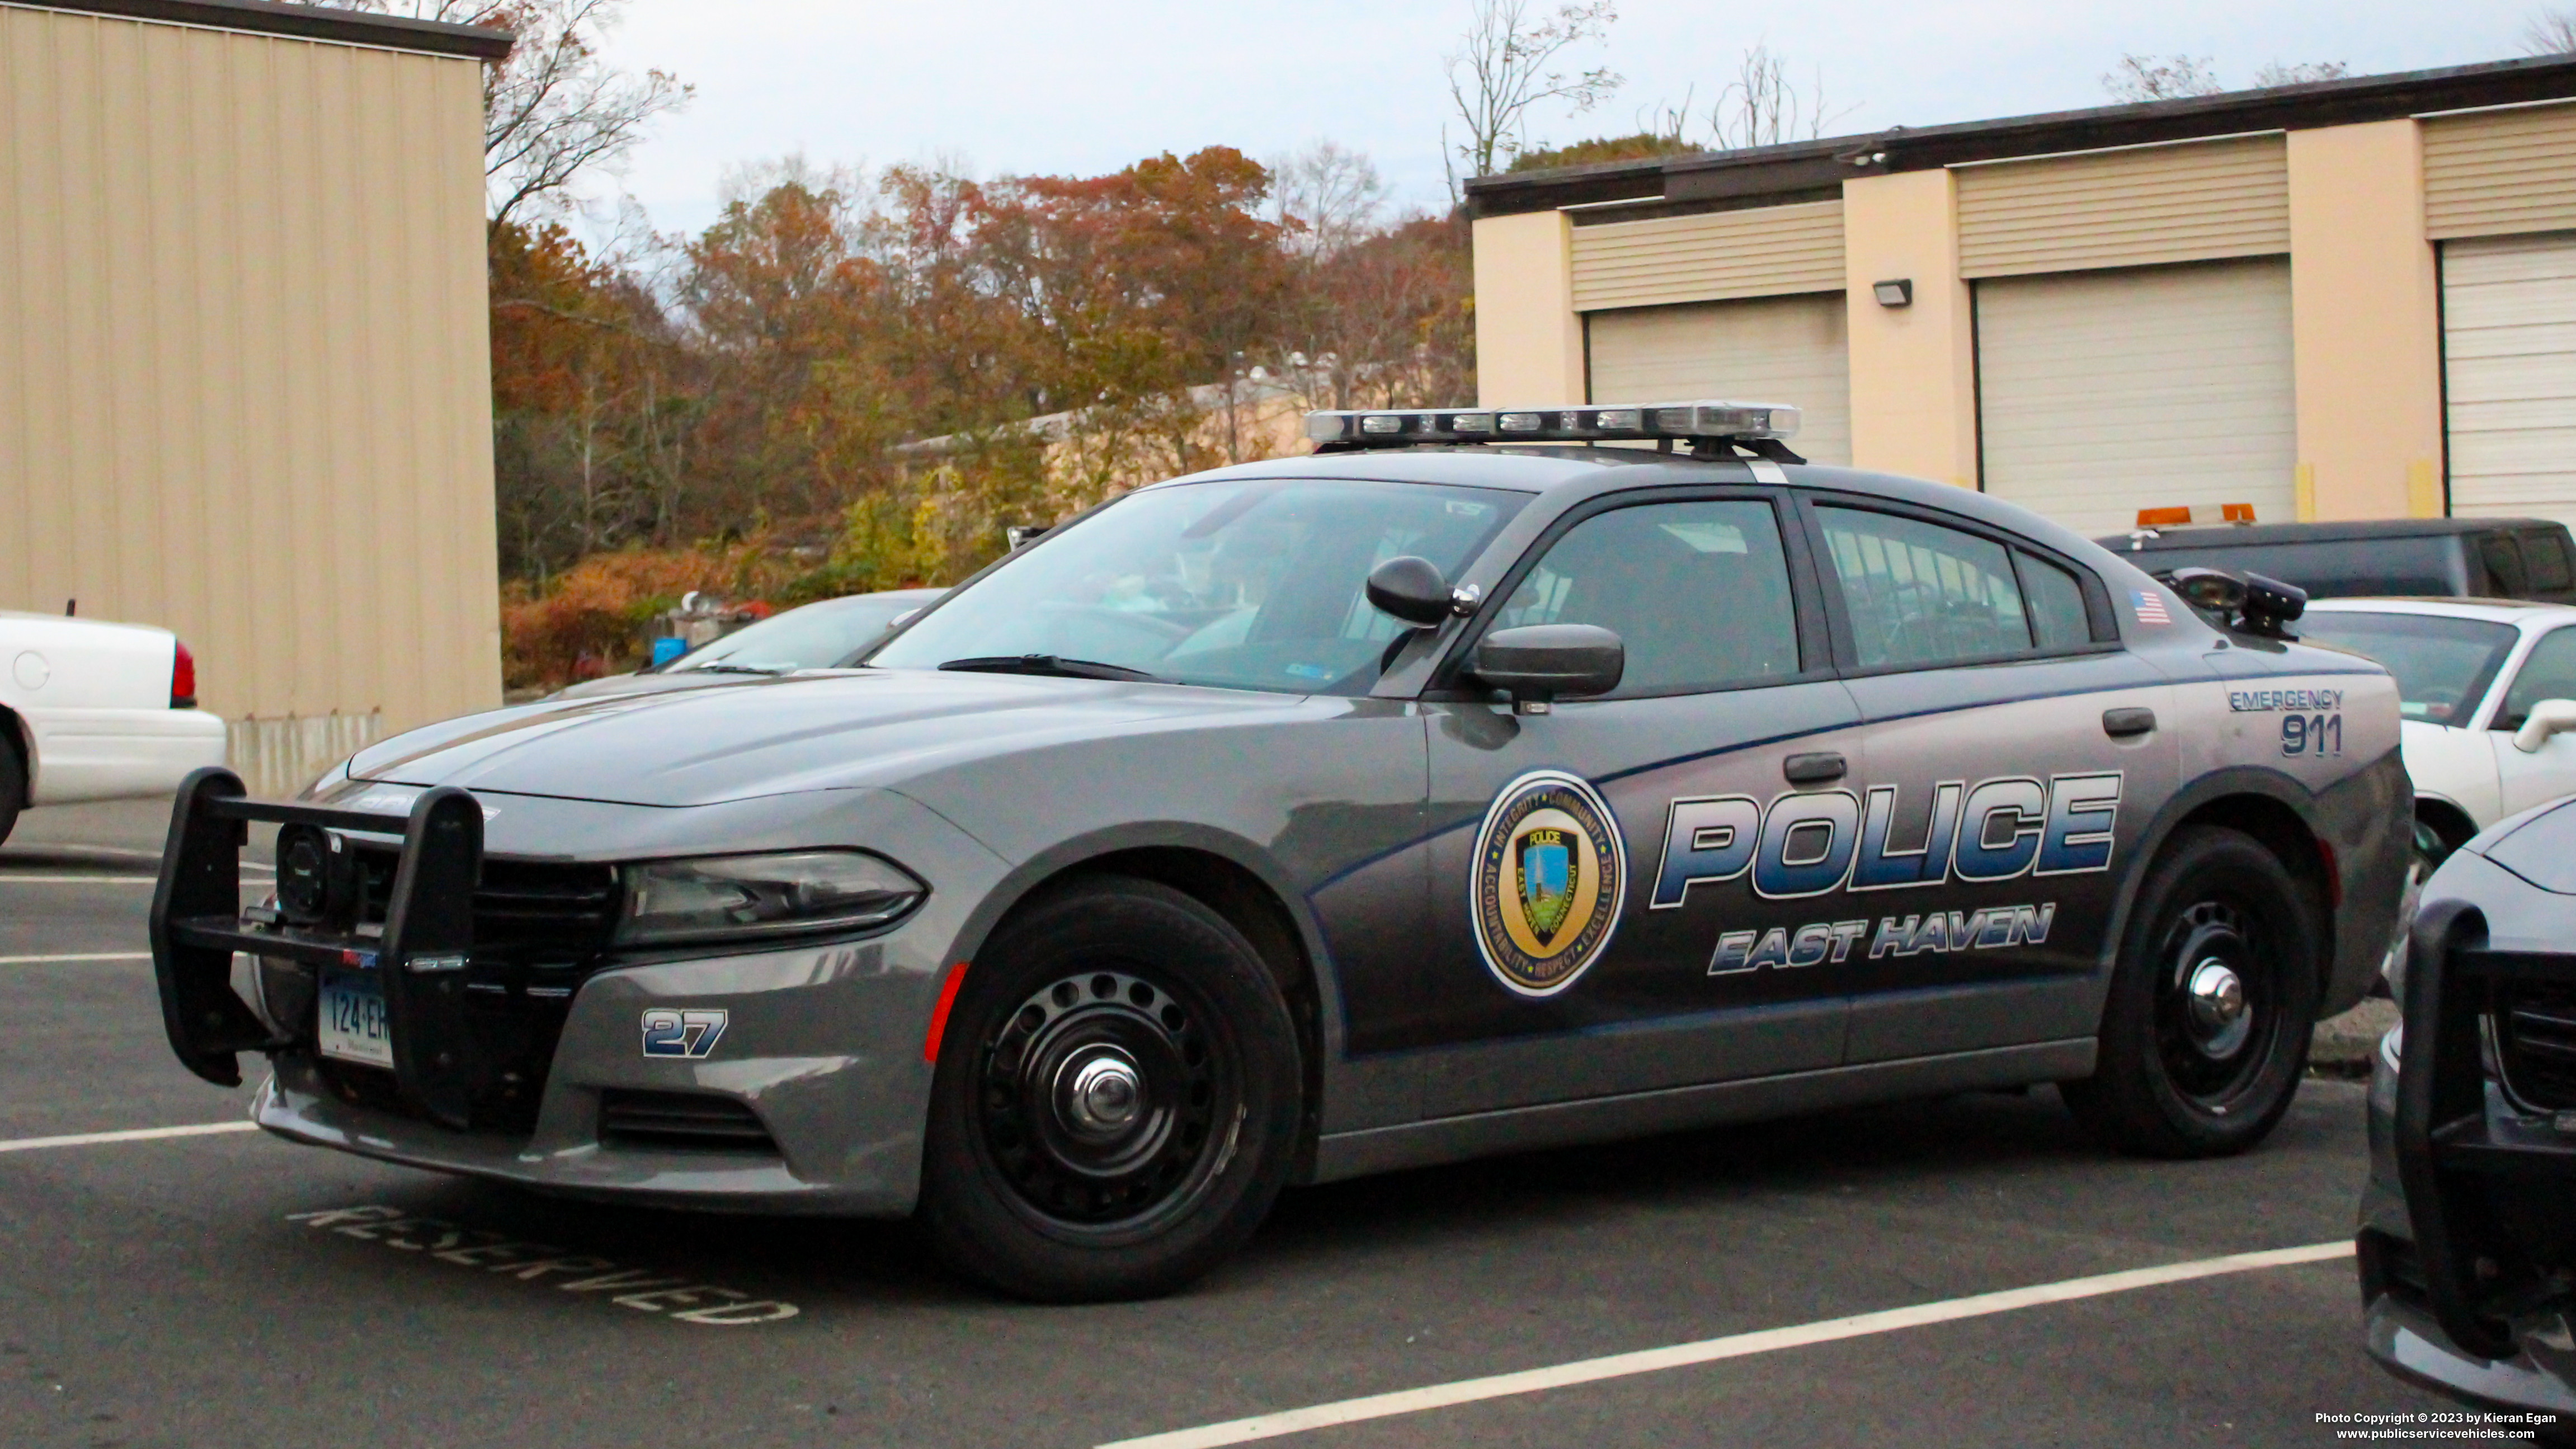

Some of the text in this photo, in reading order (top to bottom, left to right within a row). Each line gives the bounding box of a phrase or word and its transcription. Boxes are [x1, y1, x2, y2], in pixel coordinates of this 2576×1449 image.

[2230, 689, 2343, 712] EMERGENCY
[2281, 714, 2342, 757] 911
[1494, 793, 1541, 848] INTEGRITY
[1529, 830, 1561, 846] POLICE
[1548, 792, 1607, 849] COMMUNITY
[1650, 771, 2123, 909] POLICE
[1517, 867, 1526, 898] EAST
[1550, 864, 1577, 934] CONNECTICUT
[1583, 853, 1613, 947] EXCELLENCE
[1484, 863, 1528, 973] ACCOUNTABILITY
[1707, 902, 2056, 976] EAST HAVEN
[1535, 948, 1577, 977] RESPECT
[642, 1008, 728, 1058] 27
